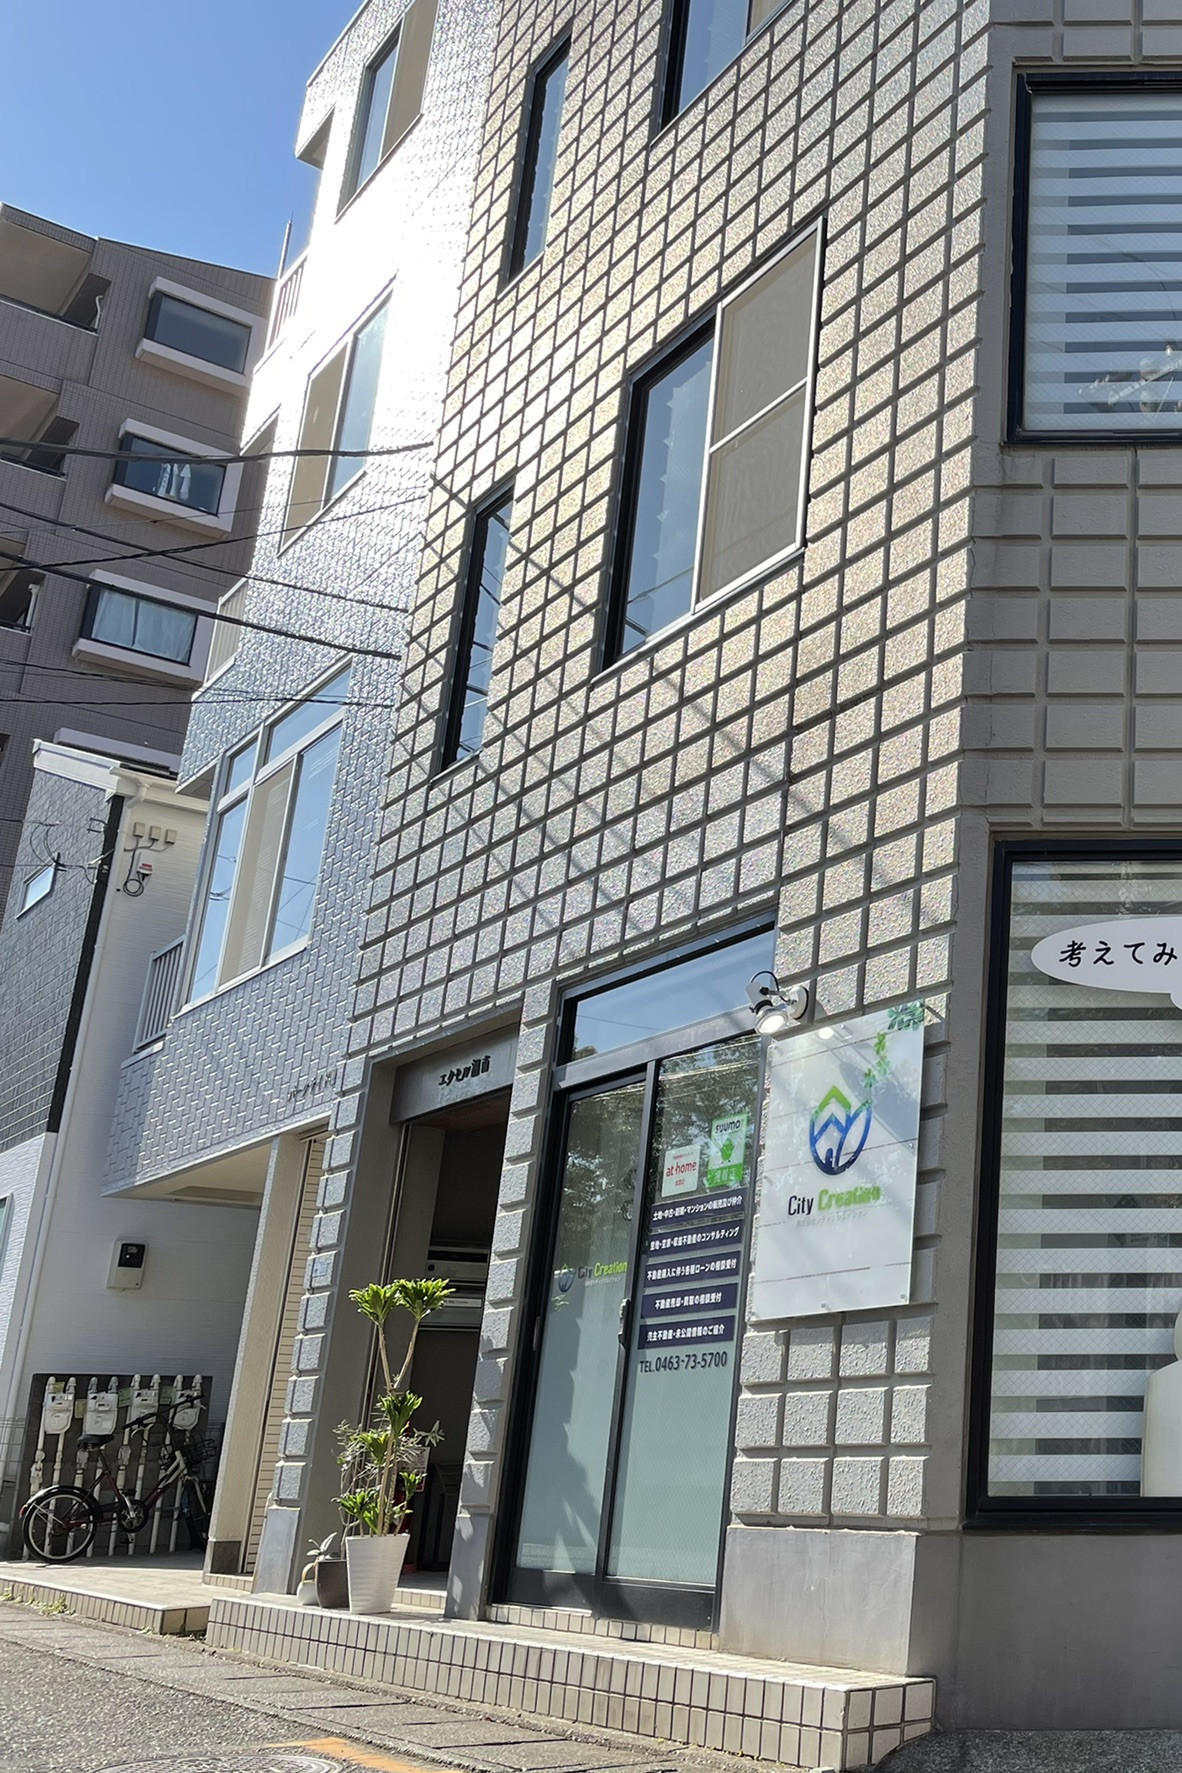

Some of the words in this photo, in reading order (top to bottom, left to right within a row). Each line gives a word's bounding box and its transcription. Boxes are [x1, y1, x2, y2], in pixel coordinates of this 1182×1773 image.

[787, 1194, 815, 1216] City
[818, 1183, 882, 1211] Creation
[594, 1262, 628, 1277] Creation
